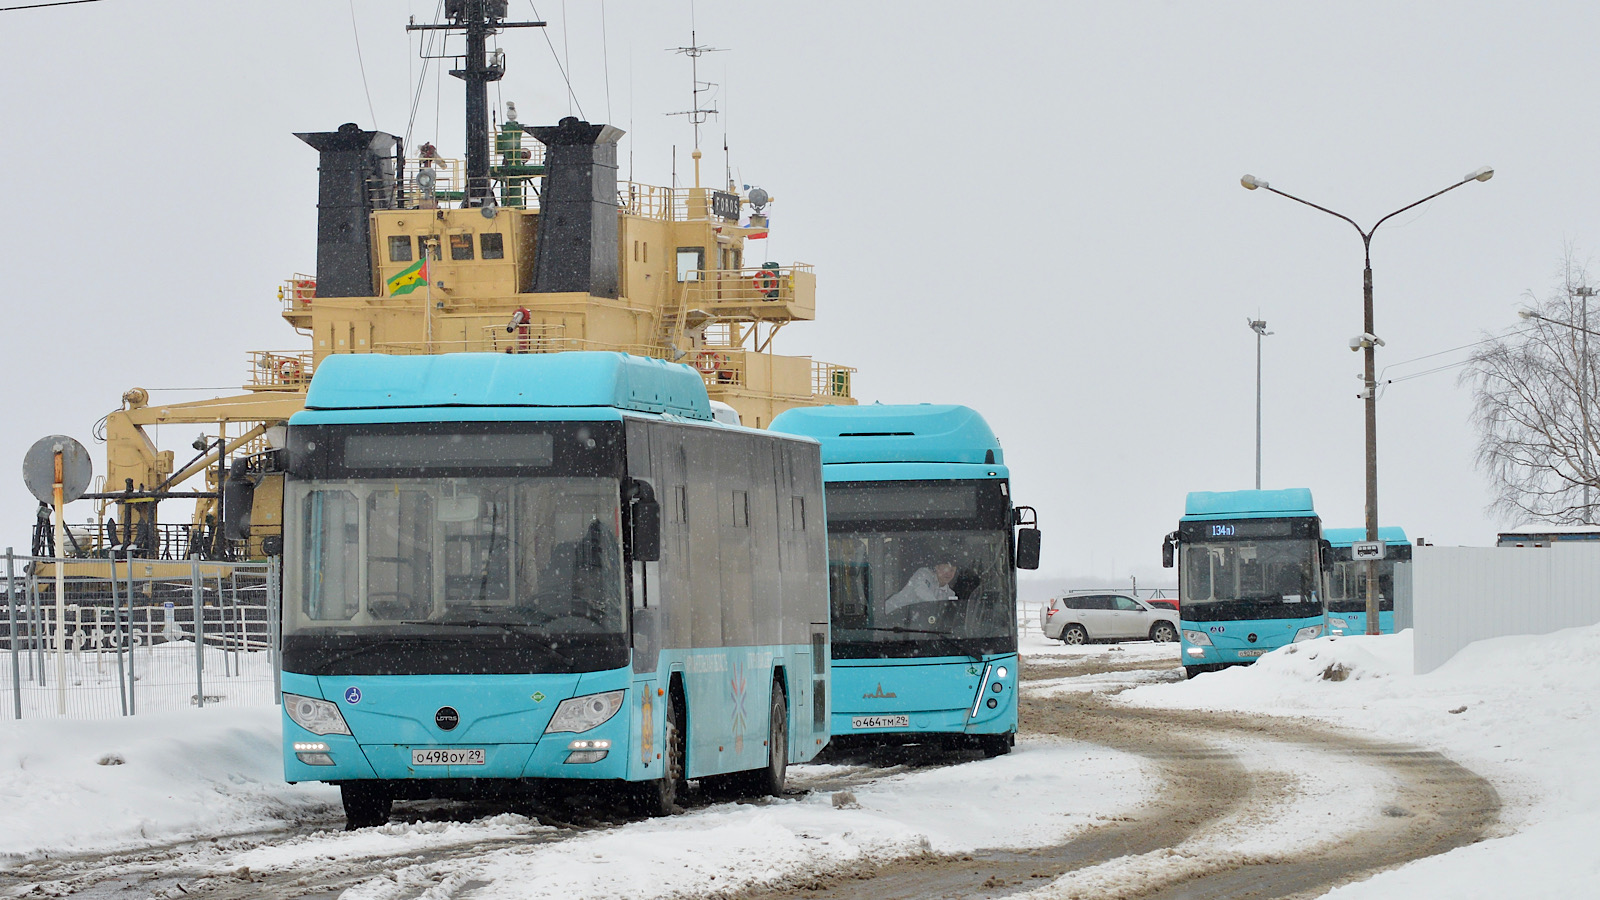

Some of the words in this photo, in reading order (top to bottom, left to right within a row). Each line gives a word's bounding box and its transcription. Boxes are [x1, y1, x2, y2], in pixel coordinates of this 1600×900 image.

[716, 196, 738, 215] FOROS
[896, 716, 906, 724] 29
[416, 751, 465, 763] О498ОУ
[468, 750, 481, 760] 29
